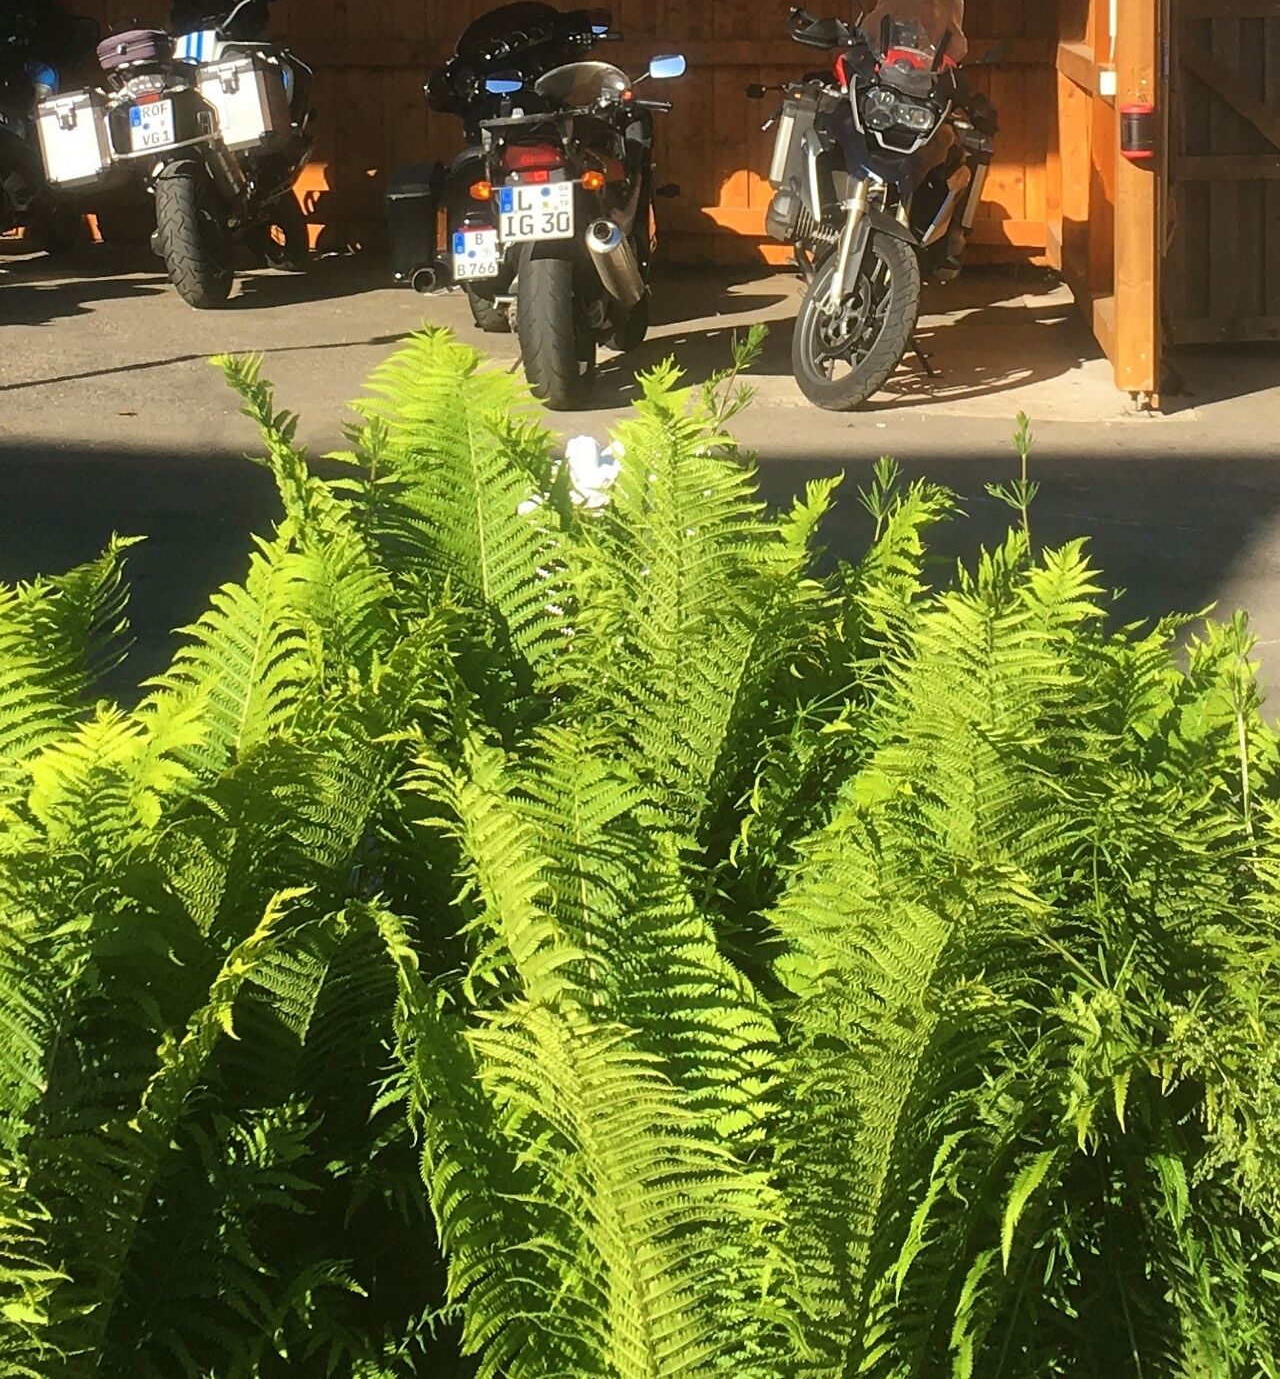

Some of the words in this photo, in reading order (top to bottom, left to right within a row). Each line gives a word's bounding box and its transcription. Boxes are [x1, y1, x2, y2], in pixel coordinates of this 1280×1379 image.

[142, 102, 167, 118] ROF
[518, 190, 532, 211] L
[505, 214, 534, 237] IG
[541, 211, 570, 234] 30
[475, 233, 484, 245] B
[457, 264, 466, 276] B
[469, 262, 495, 275] 766
